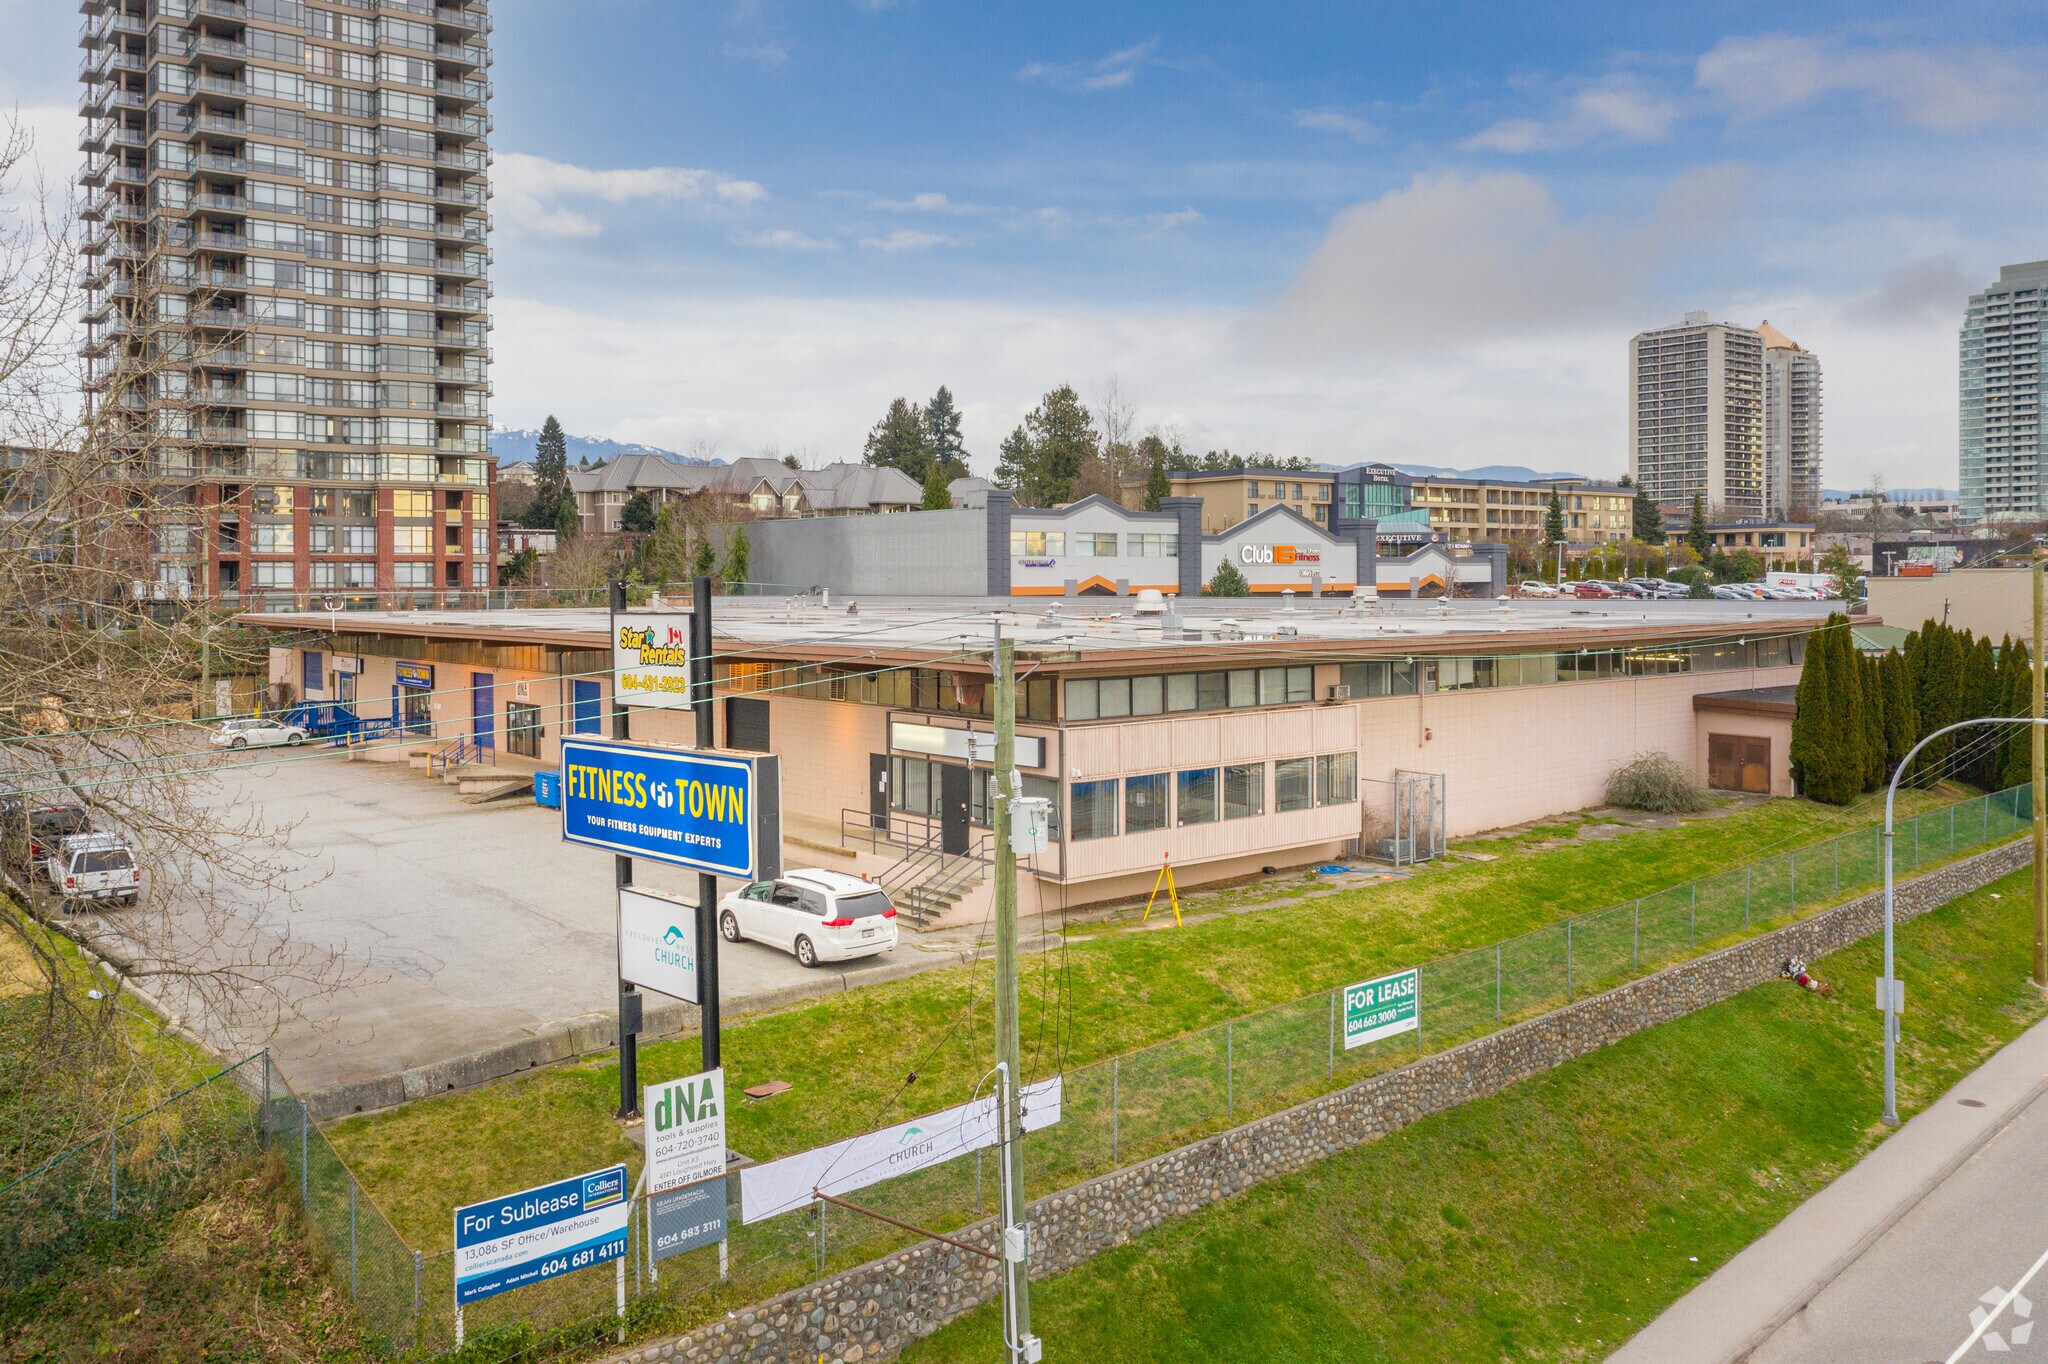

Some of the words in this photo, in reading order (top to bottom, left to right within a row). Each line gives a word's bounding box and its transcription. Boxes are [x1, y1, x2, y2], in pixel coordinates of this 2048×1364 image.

[1365, 467, 1396, 475] EXECUTIVE
[1296, 552, 1320, 562] Fitness
[620, 626, 646, 649] Star
[640, 645, 686, 668] Rentals
[621, 674, 686, 694] 604-431-2923
[568, 764, 648, 809] FITNESS
[676, 779, 744, 826] TOWN
[587, 814, 606, 828] YOUR
[608, 819, 637, 833] FITNESS
[639, 825, 682, 842] EQUIPMENT
[685, 833, 722, 849] EXPERTS
[655, 948, 694, 971] CHURCH
[1348, 988, 1374, 1011] FOR
[1378, 977, 1415, 1003] LEASE
[1348, 1018, 1362, 1032] 604
[1364, 1014, 1376, 1027] 662
[1378, 1008, 1397, 1024] 3000
[656, 1132, 676, 1142] tools
[686, 1121, 718, 1136] supplies
[656, 1132, 720, 1158] 604-720-3740
[888, 1142, 934, 1164] CHURCH
[659, 1171, 672, 1179] 4141
[673, 1162, 702, 1176] Lougheed
[704, 1158, 717, 1168] Hwy
[678, 1158, 690, 1168] Unit
[690, 1156, 699, 1164] #3
[588, 1179, 618, 1194] Colliers
[654, 1178, 676, 1192] ENTER
[678, 1175, 691, 1185] OFF
[693, 1165, 722, 1180] GILMORE
[588, 1186, 618, 1198] INTERNATIONAL
[464, 1214, 494, 1236] For
[500, 1192, 578, 1225] Sublease
[464, 1243, 498, 1260] 13,086
[502, 1238, 515, 1250] SF
[518, 1216, 600, 1246] Office/Warehouse
[657, 1232, 678, 1248] 604
[681, 1226, 700, 1240] 683
[703, 1218, 721, 1232] 3111
[465, 1250, 528, 1272] collierscanada.com
[541, 1256, 568, 1276] 604
[572, 1249, 594, 1266] 681
[599, 1240, 624, 1258] 4111
[464, 1286, 476, 1296] Mark
[478, 1282, 501, 1293] Callaghan
[506, 1276, 520, 1285] Adam
